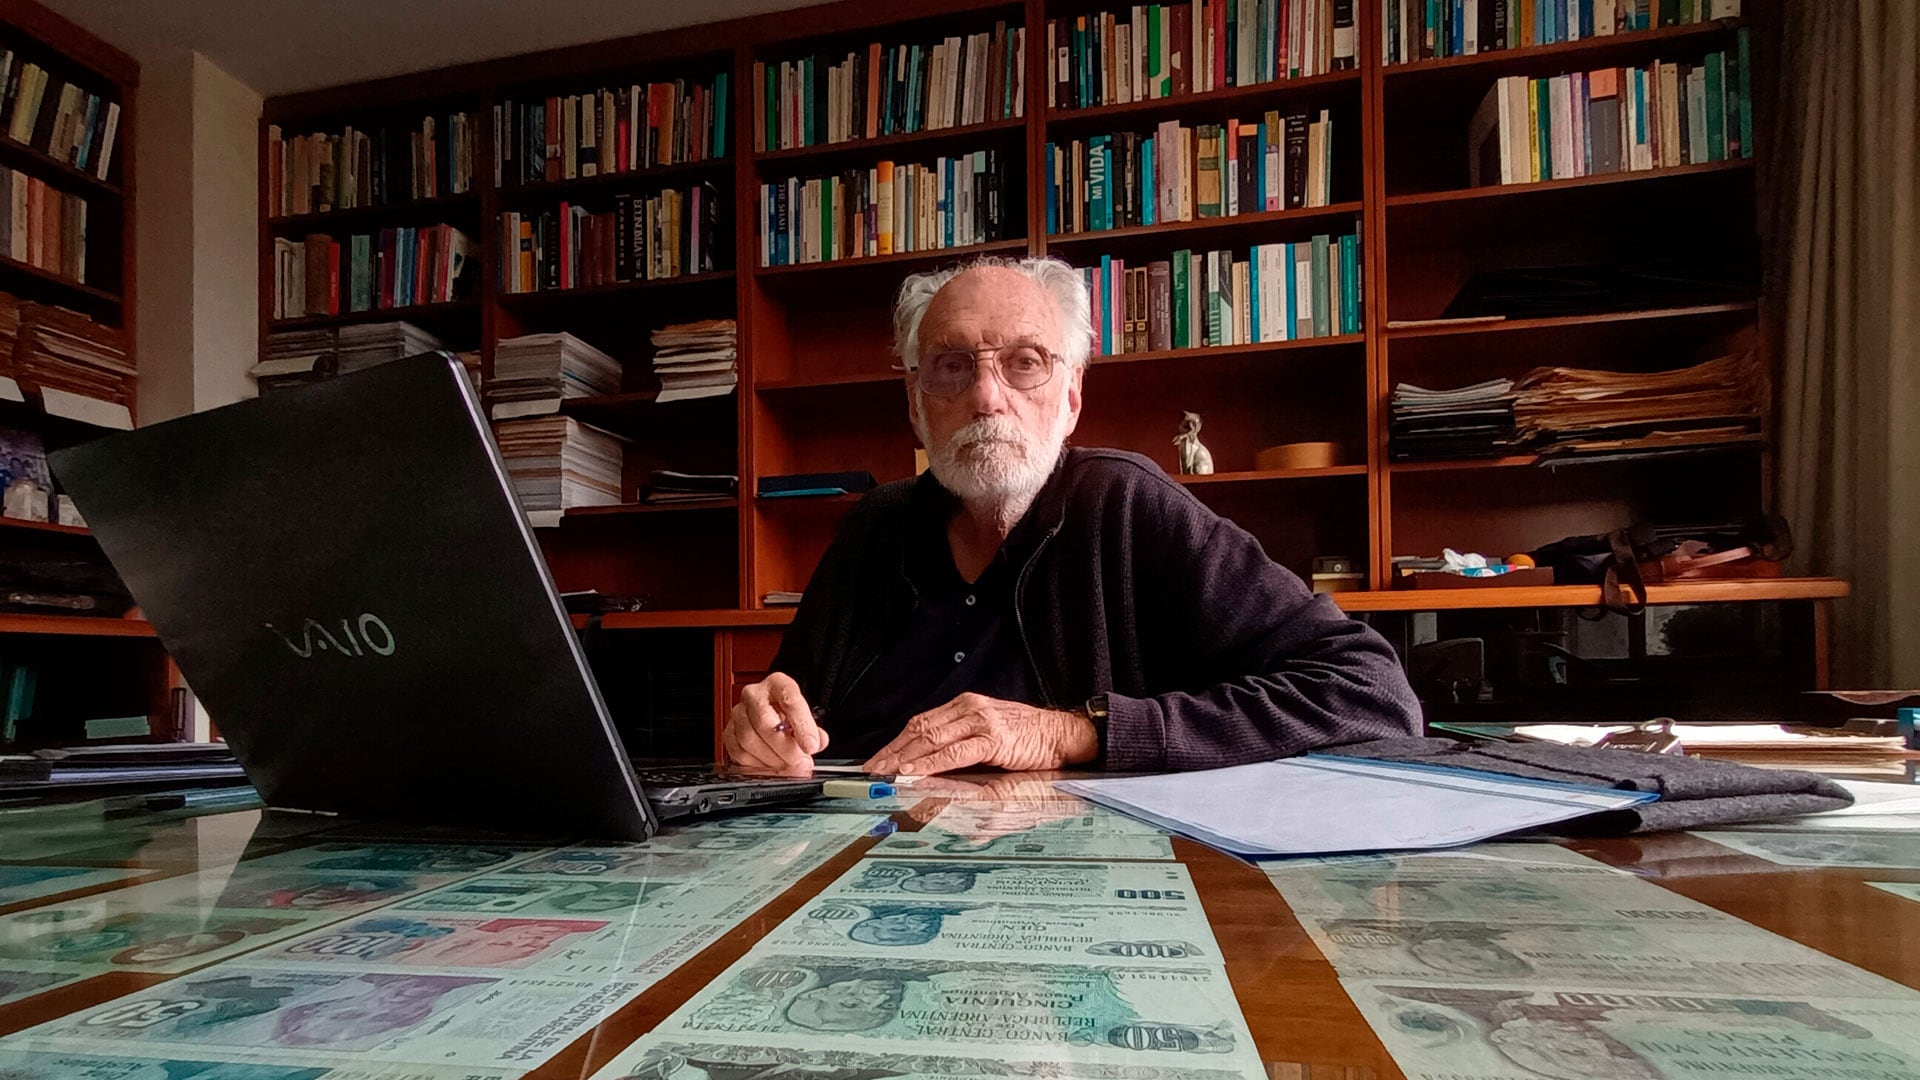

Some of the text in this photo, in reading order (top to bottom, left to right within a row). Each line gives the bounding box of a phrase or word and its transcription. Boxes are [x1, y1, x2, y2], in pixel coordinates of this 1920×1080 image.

[1494, 0, 1505, 33] OBEL
[1088, 144, 1105, 200] MI VIDA
[777, 182, 787, 232] THE SHAH
[264, 611, 397, 658] VAIO
[1114, 889, 1186, 901] 500
[940, 932, 1093, 944] REPUBLICA ARGENTINA
[1002, 924, 1048, 932] CIEN
[954, 942, 1072, 952] BANCO CENTRAL
[1118, 943, 1173, 959] 100
[598, 982, 639, 1005] BANCO
[84, 1000, 203, 1029] 50
[550, 1004, 606, 1037] CENTRAL
[899, 1009, 1096, 1029] REPUBLICA ARGENTINA
[494, 1015, 570, 1061] ARGENTINA
[533, 1036, 562, 1049] DE
[916, 1024, 1069, 1044] BANCO CENTRAL
[1124, 1026, 1183, 1052] 50
[1683, 1030, 1804, 1047] PESOS
[513, 1049, 543, 1062] LA
[1708, 1044, 1907, 1066] CINCUENTA
